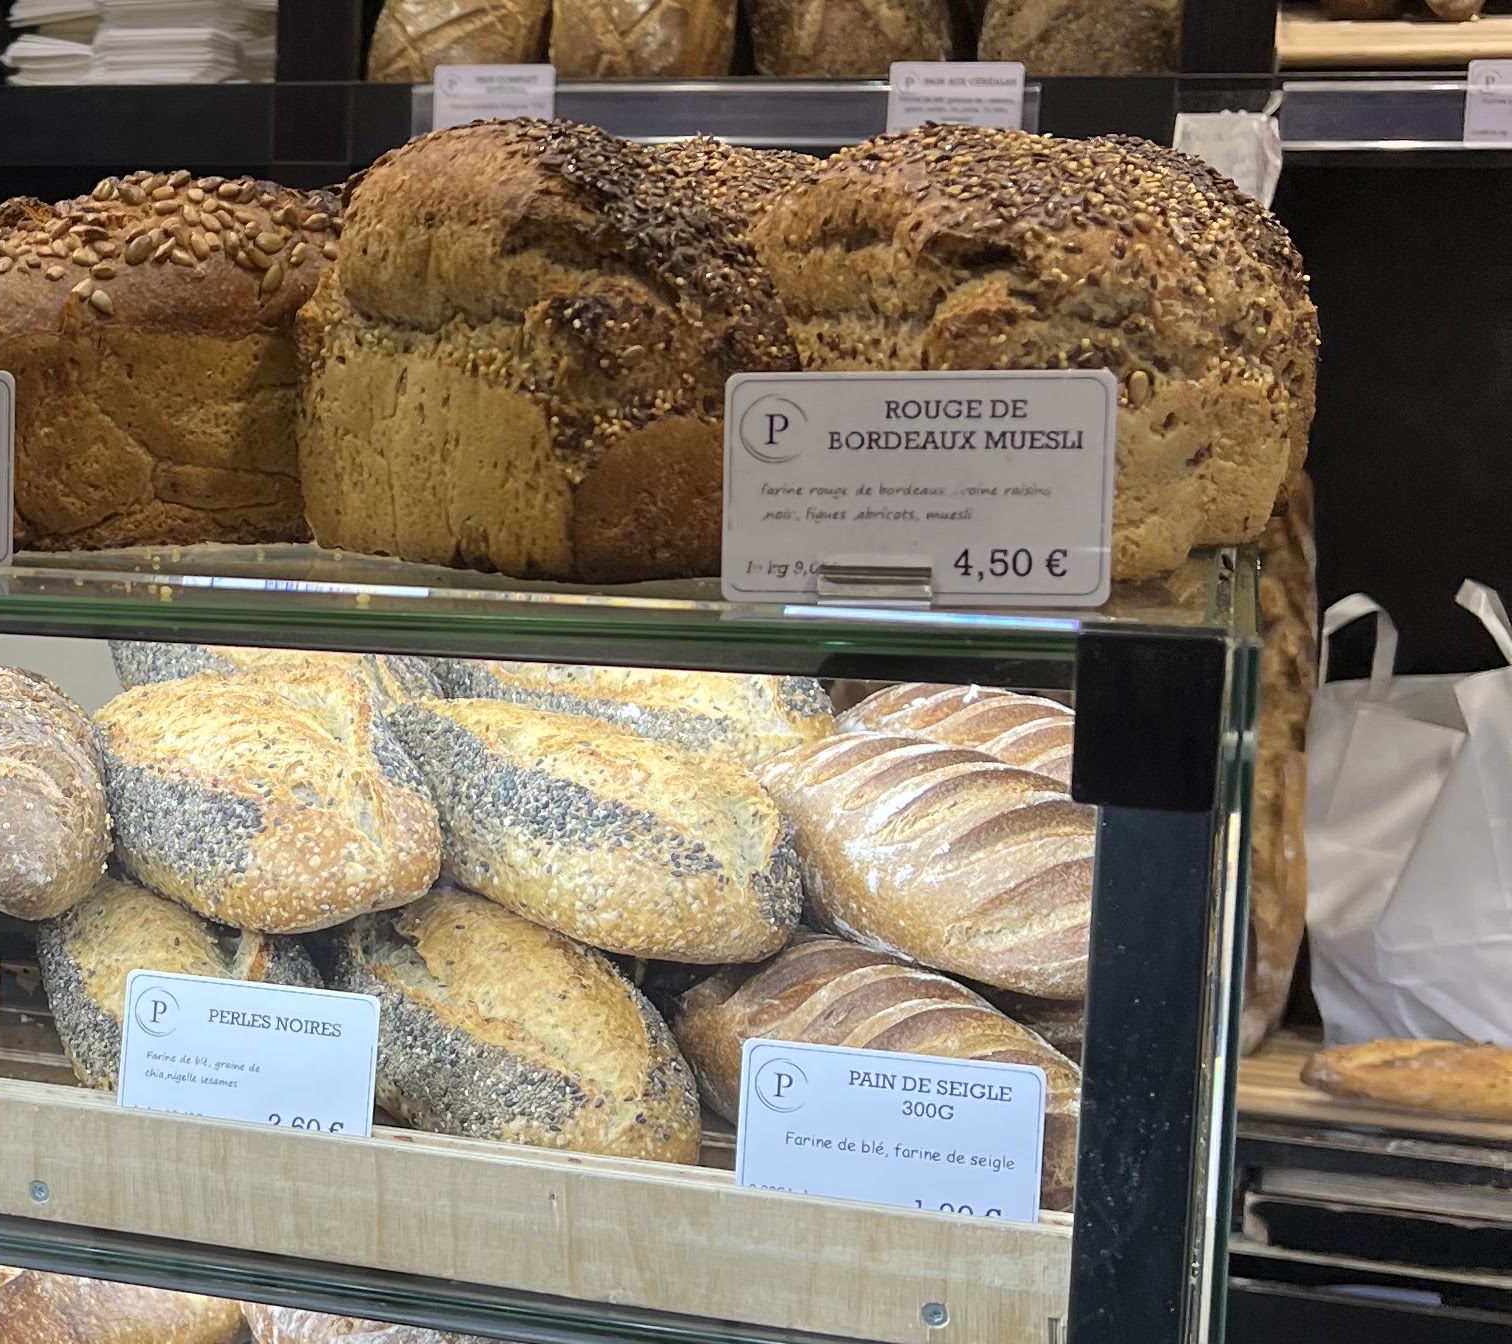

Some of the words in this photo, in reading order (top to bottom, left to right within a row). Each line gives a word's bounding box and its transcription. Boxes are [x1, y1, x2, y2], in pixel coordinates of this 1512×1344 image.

[885, 400, 982, 419] ROUGE
[989, 400, 1027, 419] DE
[764, 414, 789, 445] P
[828, 431, 976, 450] BORDEAUX
[984, 431, 1083, 450] MUESLI
[856, 484, 872, 496] de
[953, 548, 1032, 582] 4,50
[1045, 548, 1068, 577] €
[149, 1000, 167, 1023] P
[208, 1009, 271, 1029] PERLES
[275, 1016, 342, 1038] NOIRES
[147, 1051, 176, 1063] Farine
[180, 1053, 191, 1064] de
[214, 1060, 245, 1072] graine
[249, 1062, 260, 1073] de
[201, 1075, 238, 1088] sesames
[773, 1073, 793, 1098] P
[849, 1070, 897, 1090] PAIN
[901, 1075, 931, 1094] DE
[937, 1080, 1012, 1102] SEIGLE
[901, 1101, 954, 1120] 300G
[785, 1131, 832, 1149] Farine
[838, 1137, 856, 1152] de
[861, 1140, 888, 1157] blé,
[894, 1144, 941, 1162] farine
[946, 1150, 965, 1165] de
[970, 1155, 1015, 1172] seigle
